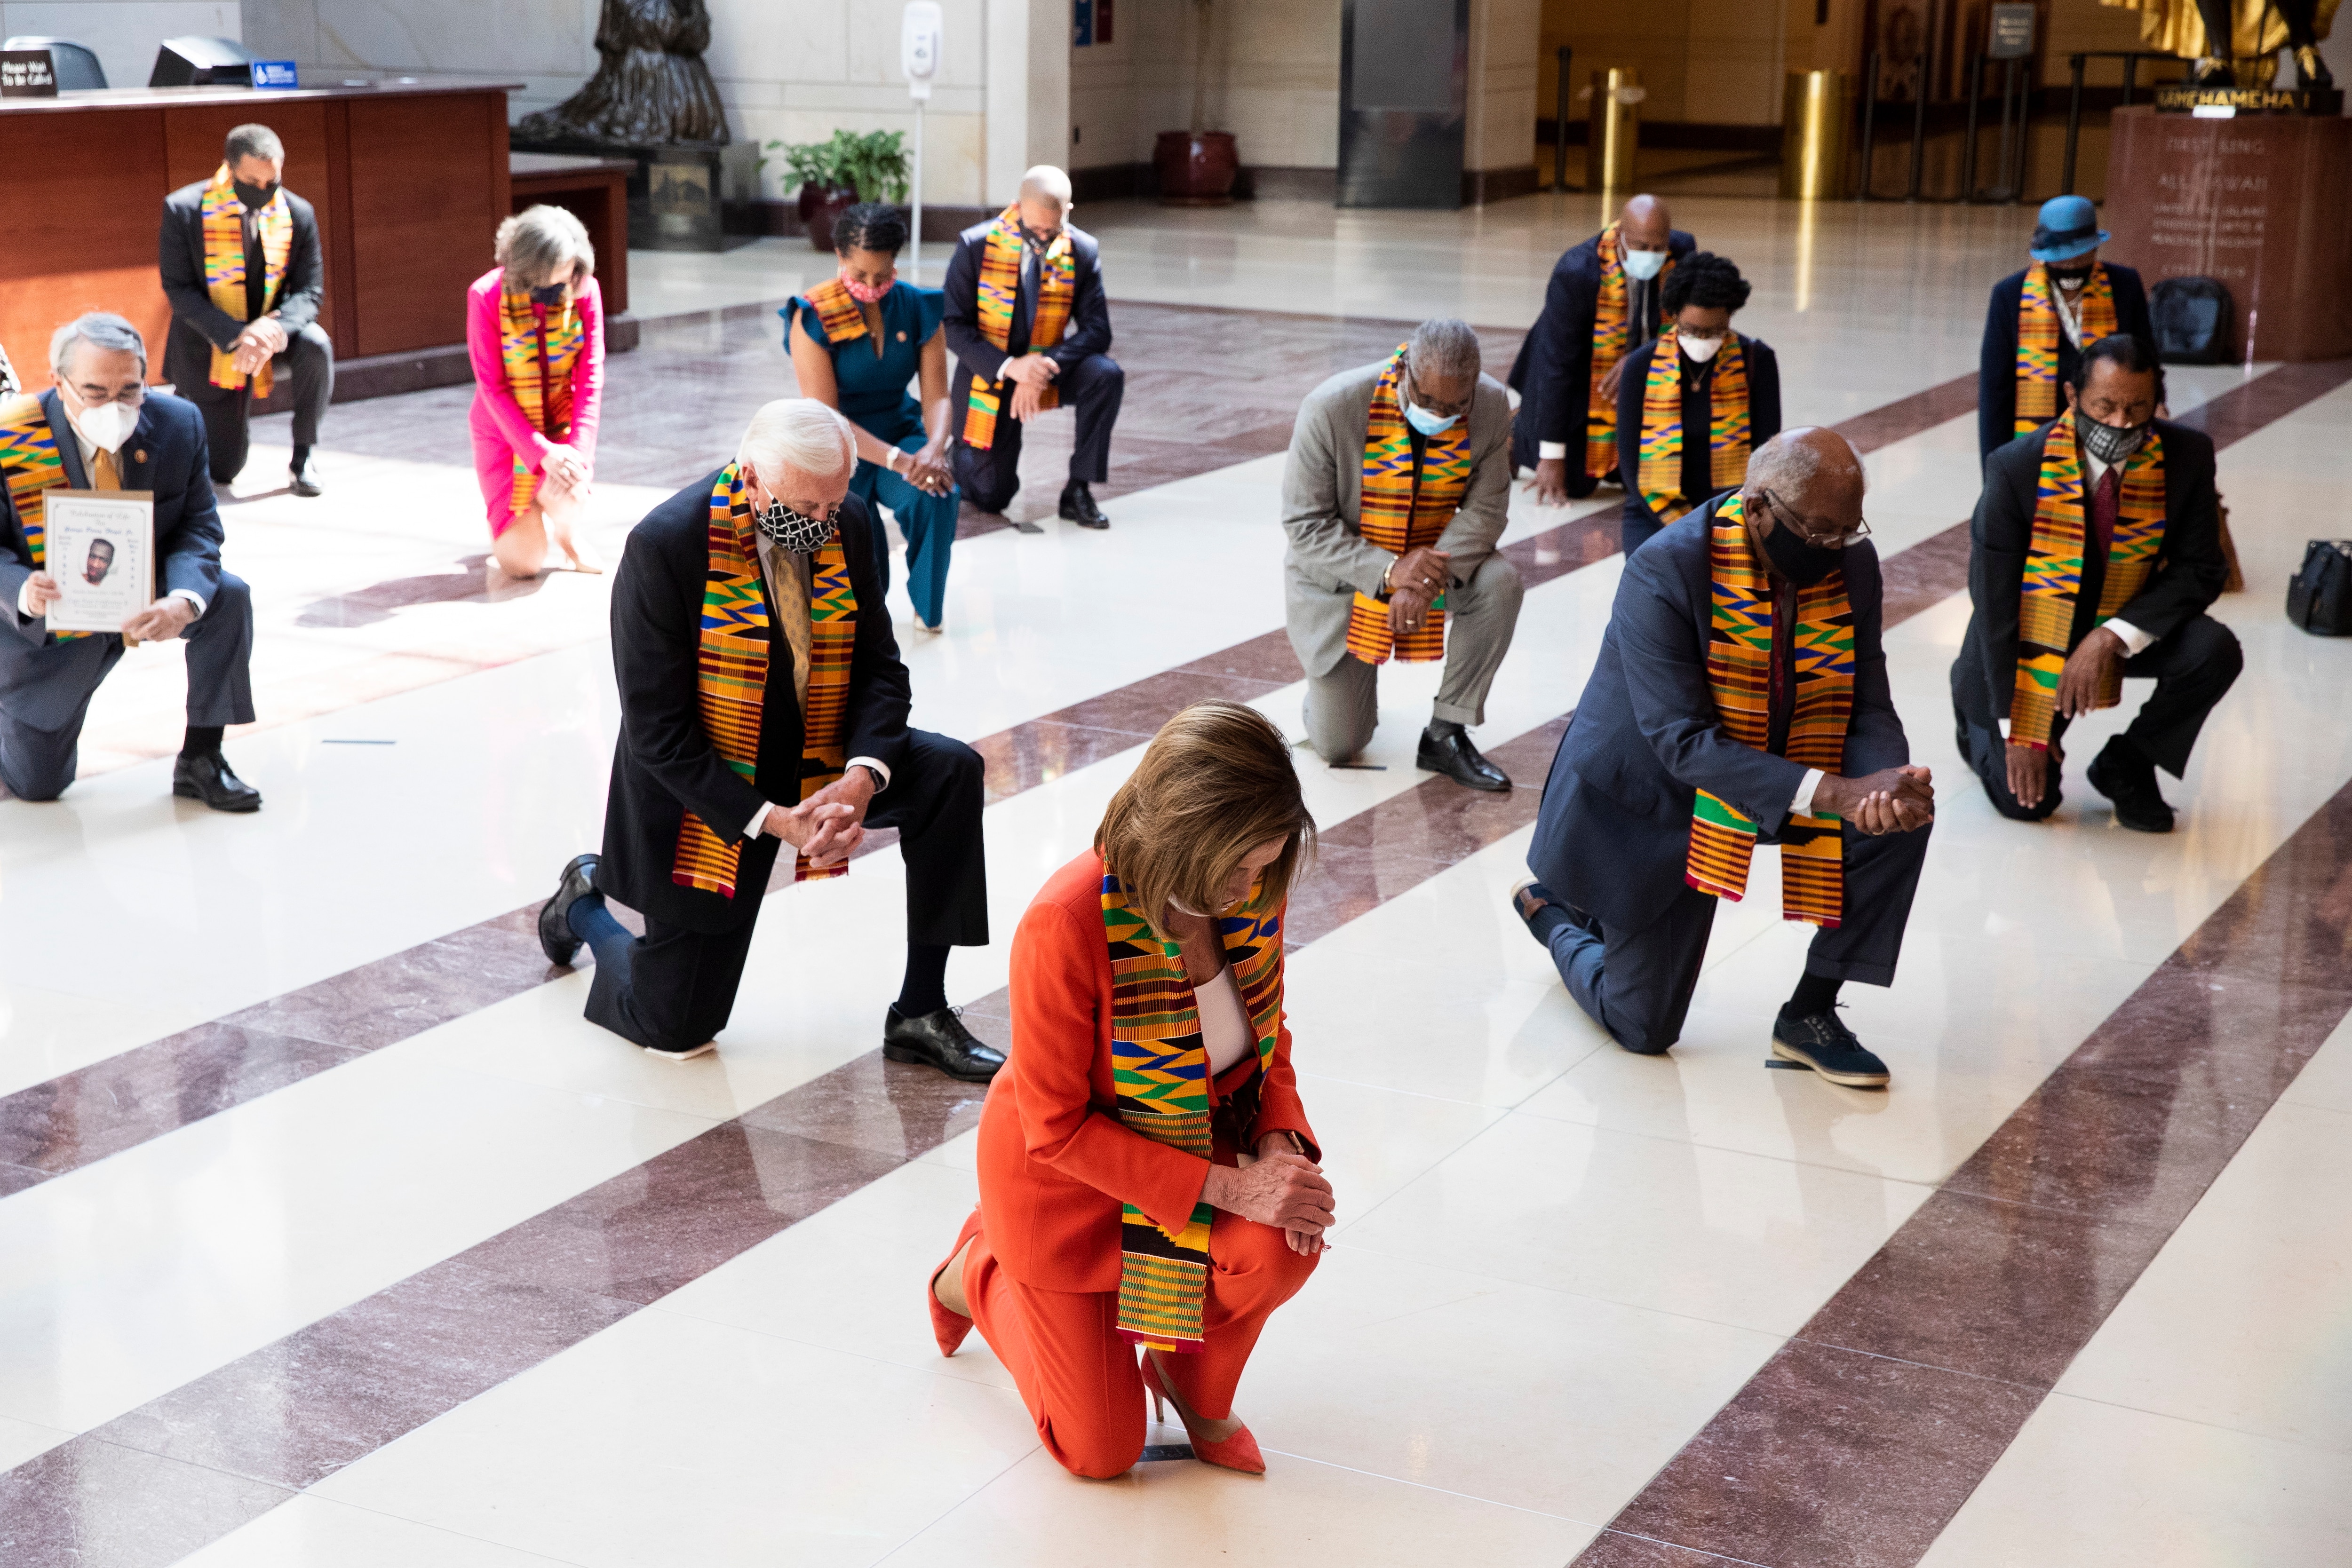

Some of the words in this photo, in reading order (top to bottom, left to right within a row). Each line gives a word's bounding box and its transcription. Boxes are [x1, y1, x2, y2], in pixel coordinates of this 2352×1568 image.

[1, 61, 27, 74] Please
[27, 61, 48, 73] Wait
[1, 73, 14, 86] To
[14, 73, 26, 86] Be
[27, 72, 53, 86] Called
[2218, 138, 2265, 155] KING
[2197, 174, 2268, 191] AWAII
